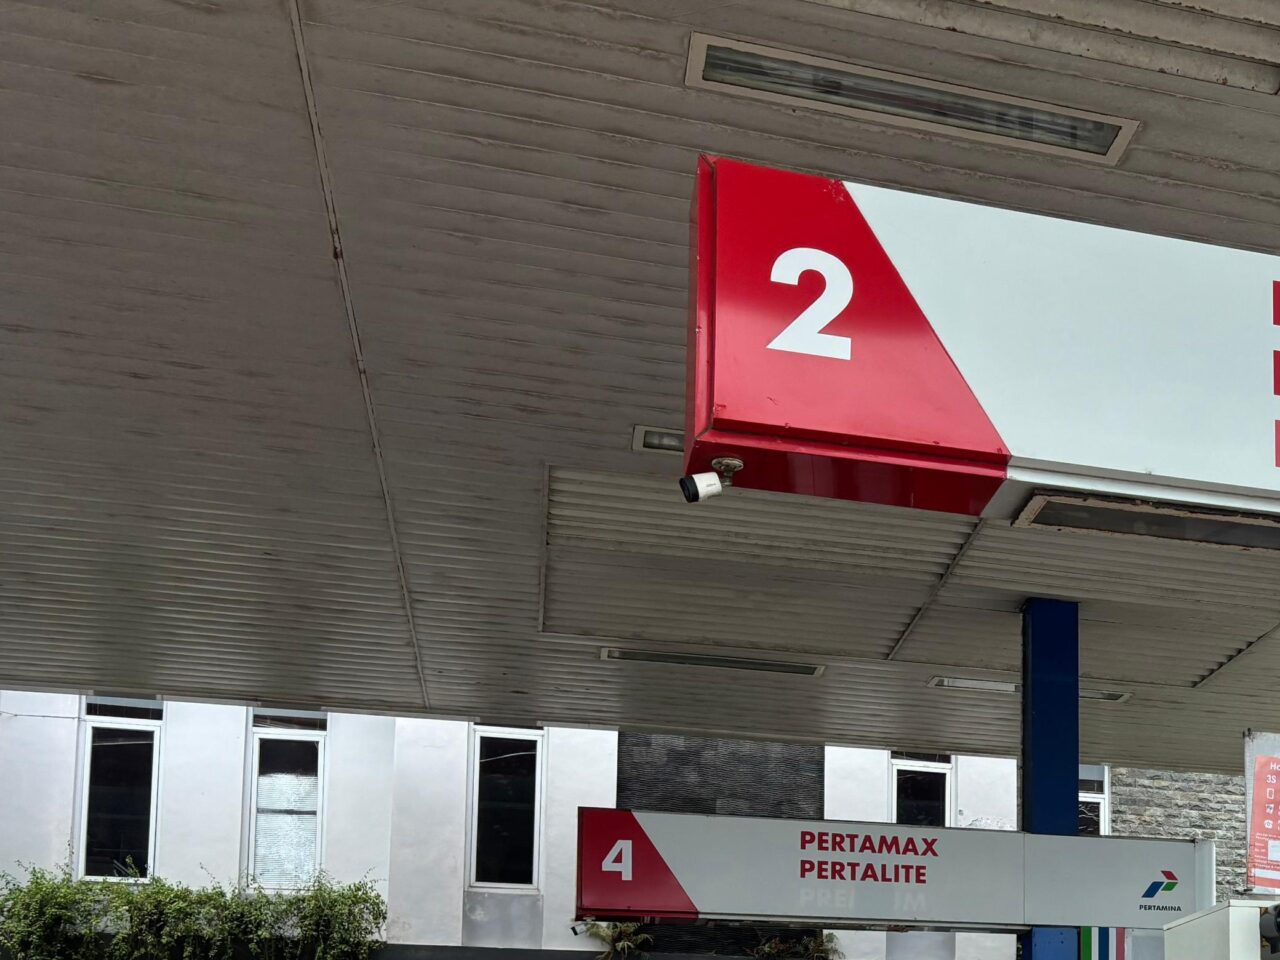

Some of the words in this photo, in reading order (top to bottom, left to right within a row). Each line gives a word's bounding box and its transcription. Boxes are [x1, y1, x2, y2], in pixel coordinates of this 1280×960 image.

[765, 247, 854, 361] 2
[1266, 774, 1277, 784] 3S
[800, 830, 939, 857] PERTAMAX
[602, 839, 633, 881] 4
[800, 859, 927, 885] PERTALITE
